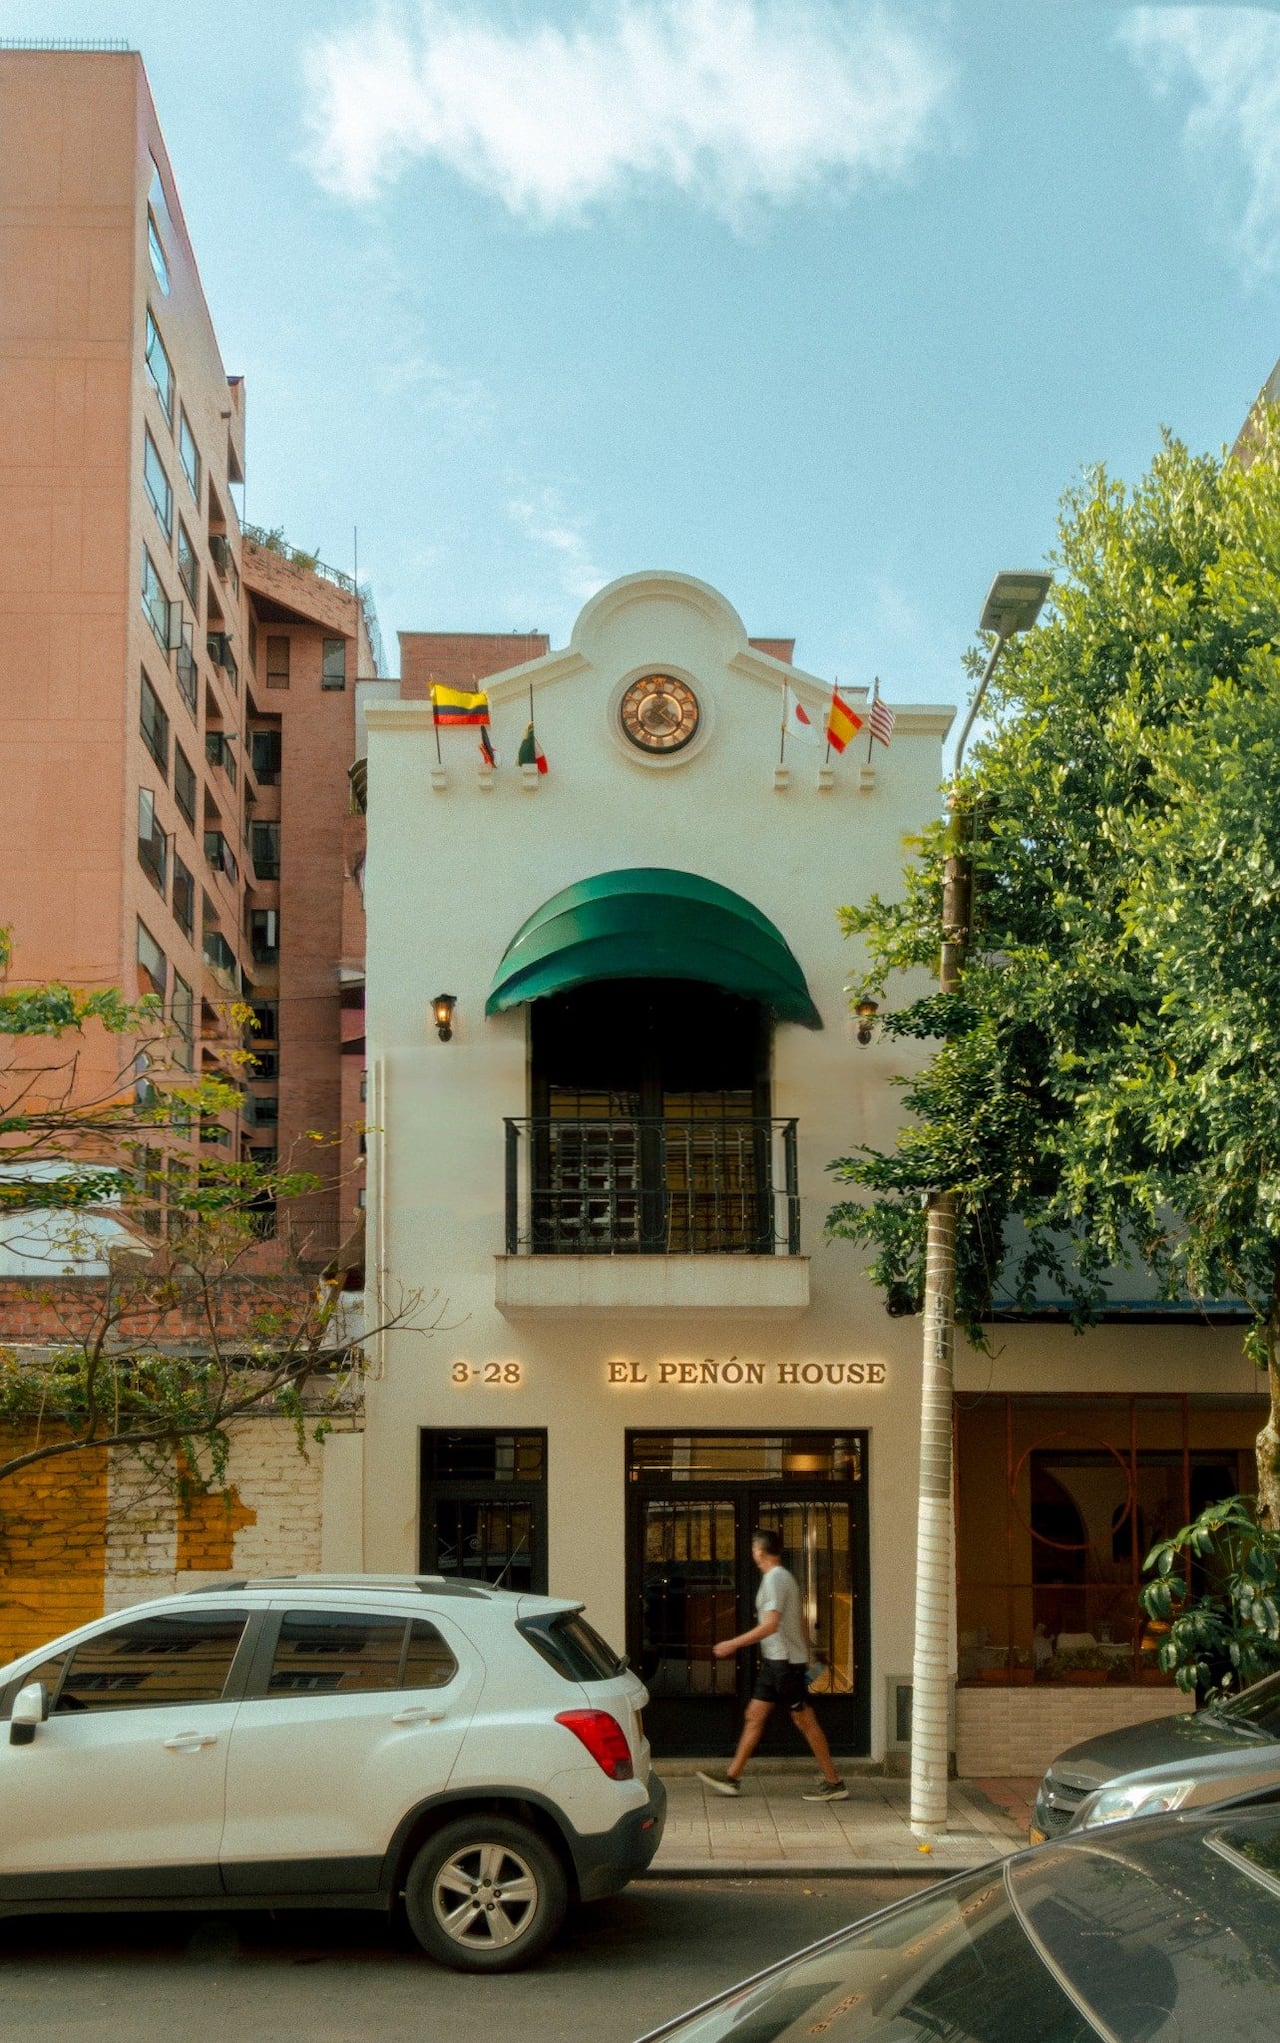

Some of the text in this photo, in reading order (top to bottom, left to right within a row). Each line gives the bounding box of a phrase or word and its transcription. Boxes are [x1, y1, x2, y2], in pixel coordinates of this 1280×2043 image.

[452, 1362, 520, 1384] 3-28
[608, 1355, 886, 1385] EL PEÑÓN HOUSE
